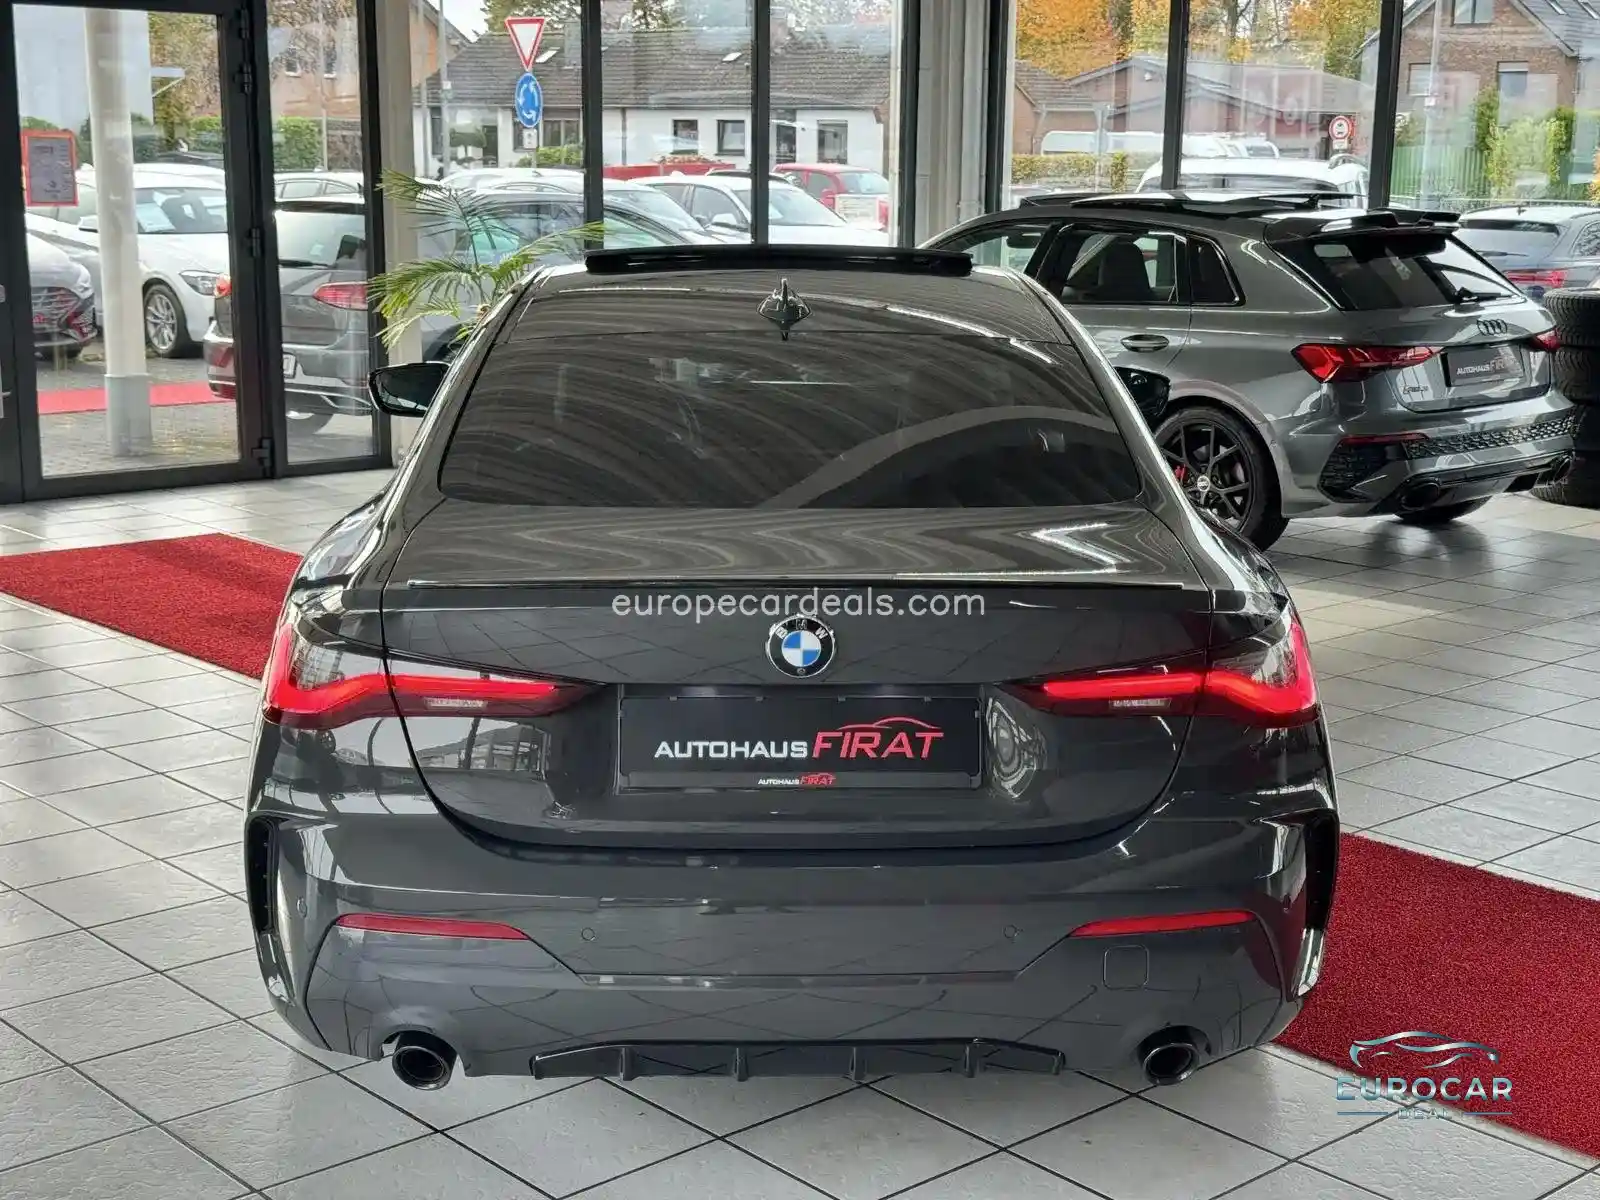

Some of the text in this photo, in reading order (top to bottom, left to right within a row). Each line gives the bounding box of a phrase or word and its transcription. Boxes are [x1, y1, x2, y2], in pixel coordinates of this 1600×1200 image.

[654, 731, 945, 760] AUTOHAUS FIRAT
[757, 775, 836, 786] AUTOHAUS FIRAT
